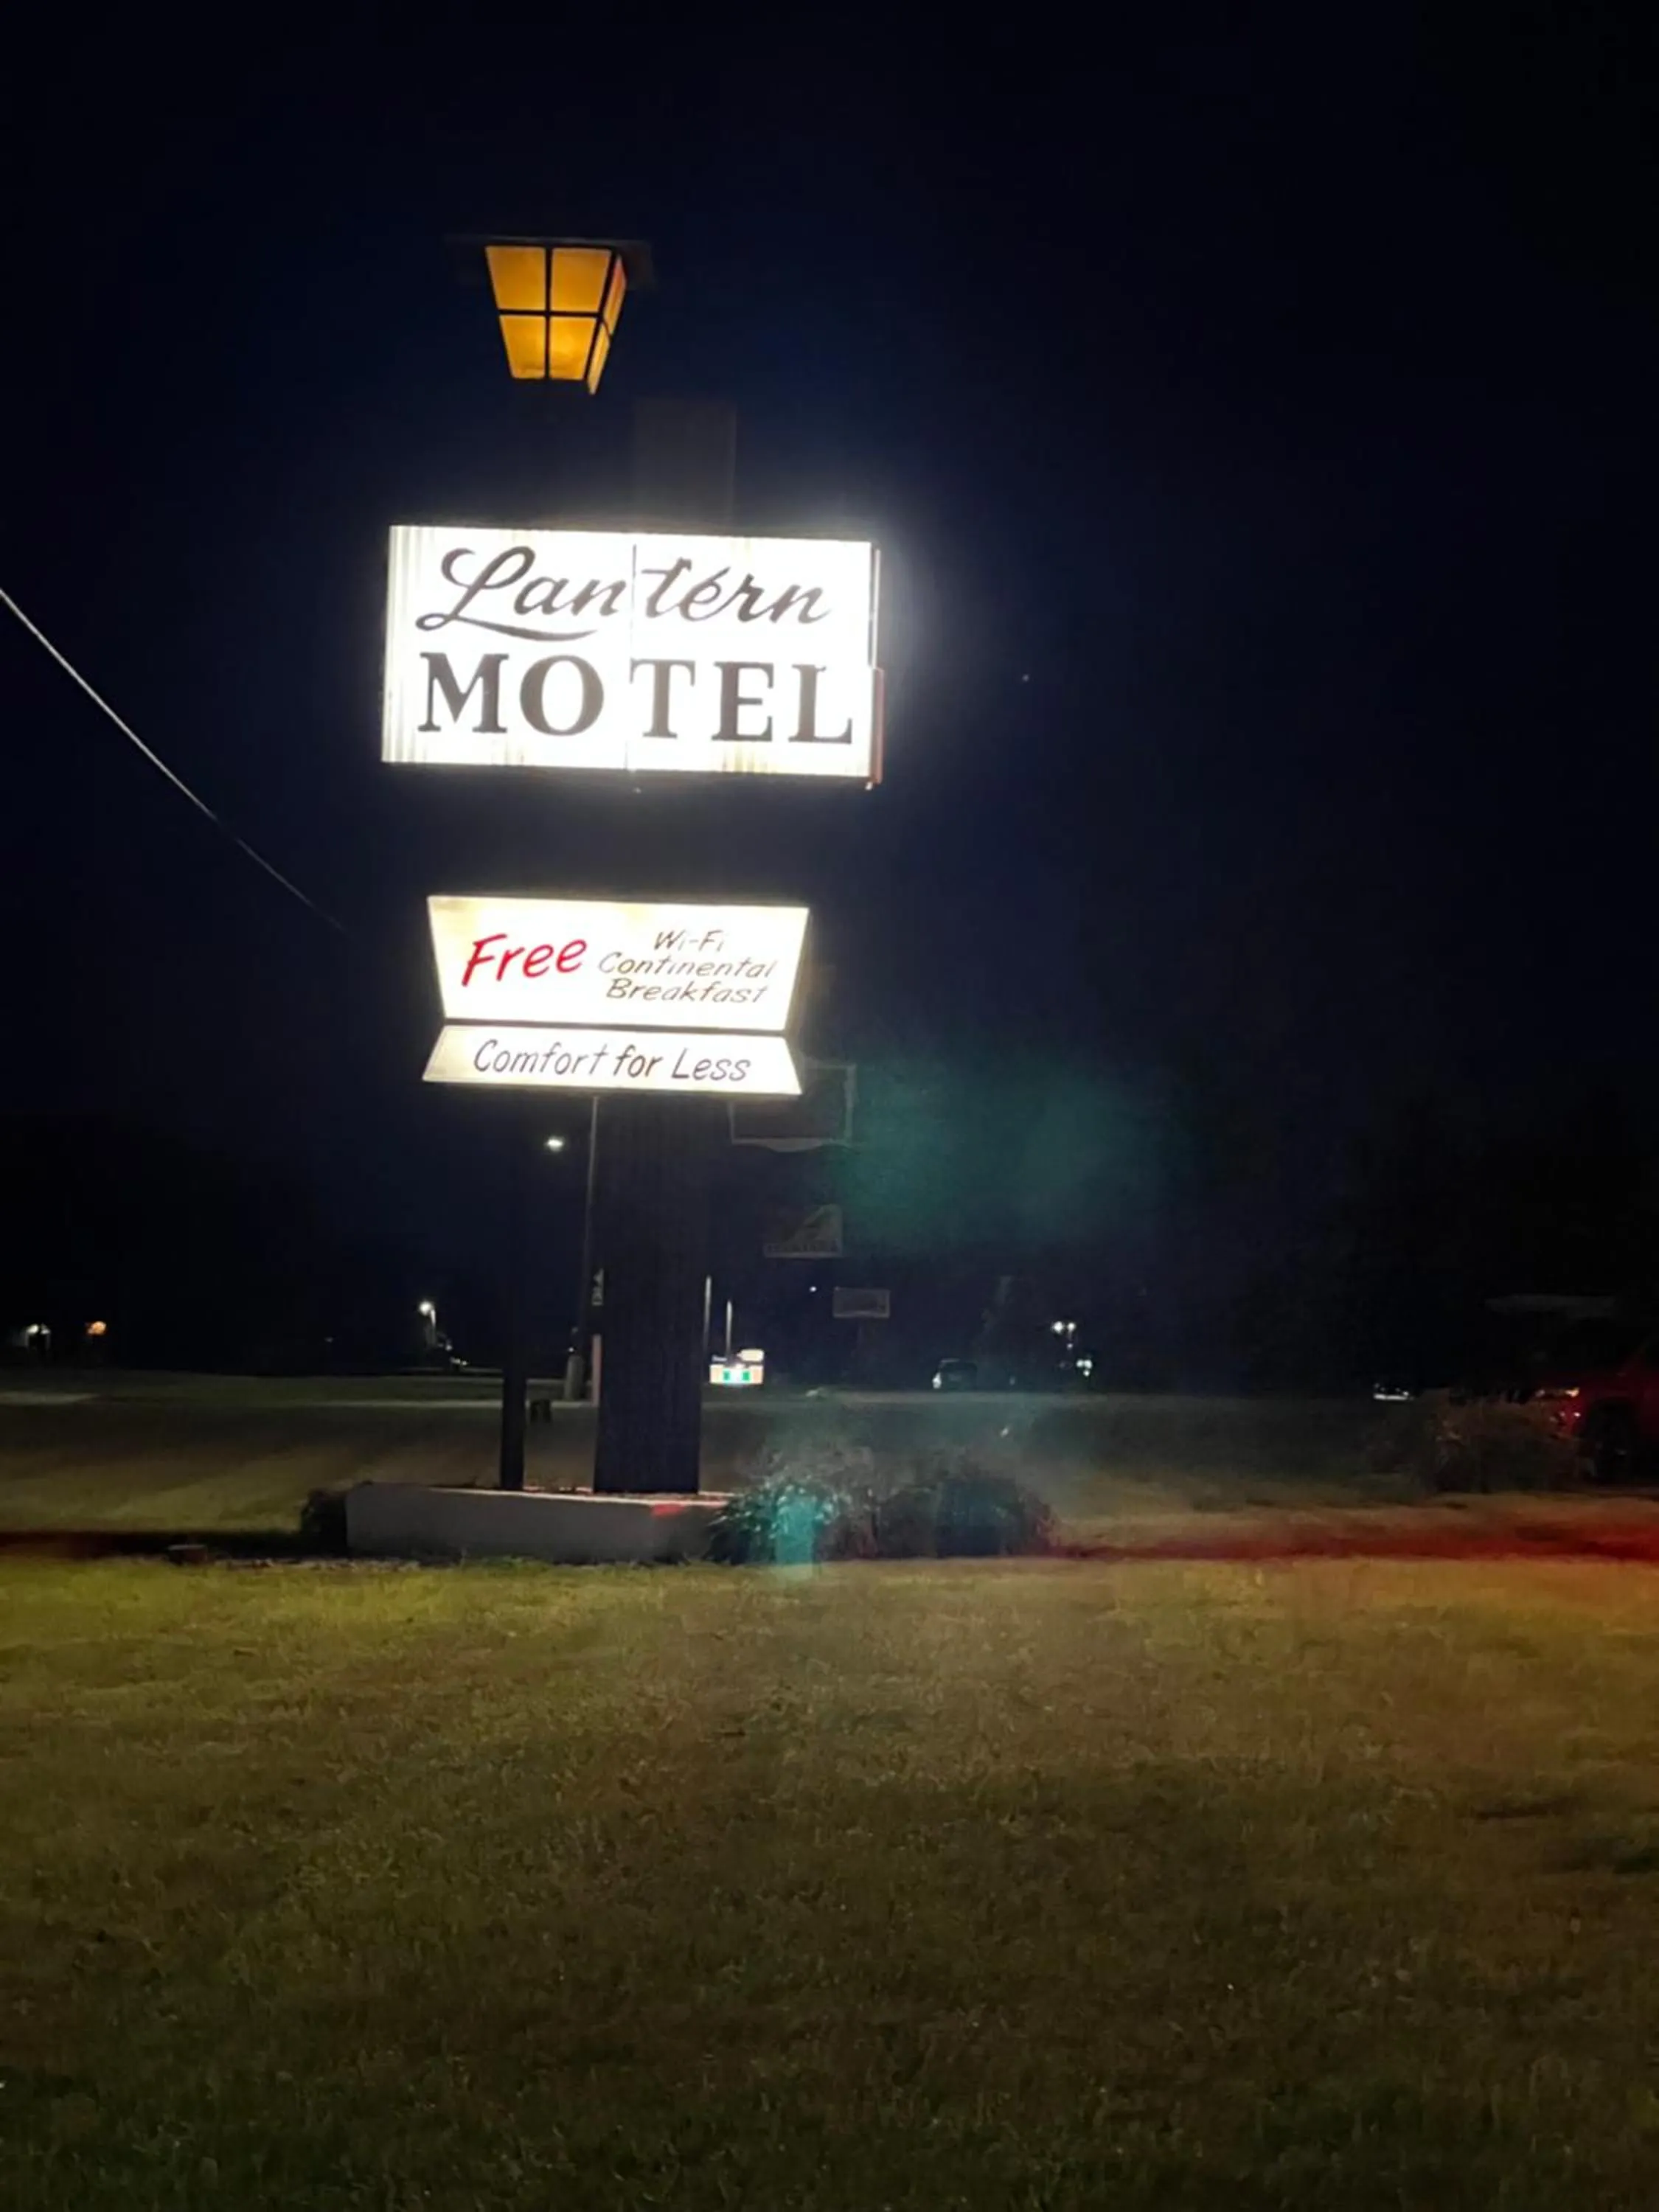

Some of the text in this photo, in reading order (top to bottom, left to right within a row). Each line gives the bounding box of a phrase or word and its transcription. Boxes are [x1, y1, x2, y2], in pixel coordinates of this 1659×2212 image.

[417, 652, 853, 745] MOTEL
[654, 928, 726, 952] Wi-Fi
[462, 933, 588, 987] Free
[598, 952, 777, 978] Continental
[606, 978, 768, 1004] Breakfast
[473, 1039, 751, 1082] Comfort for Less
